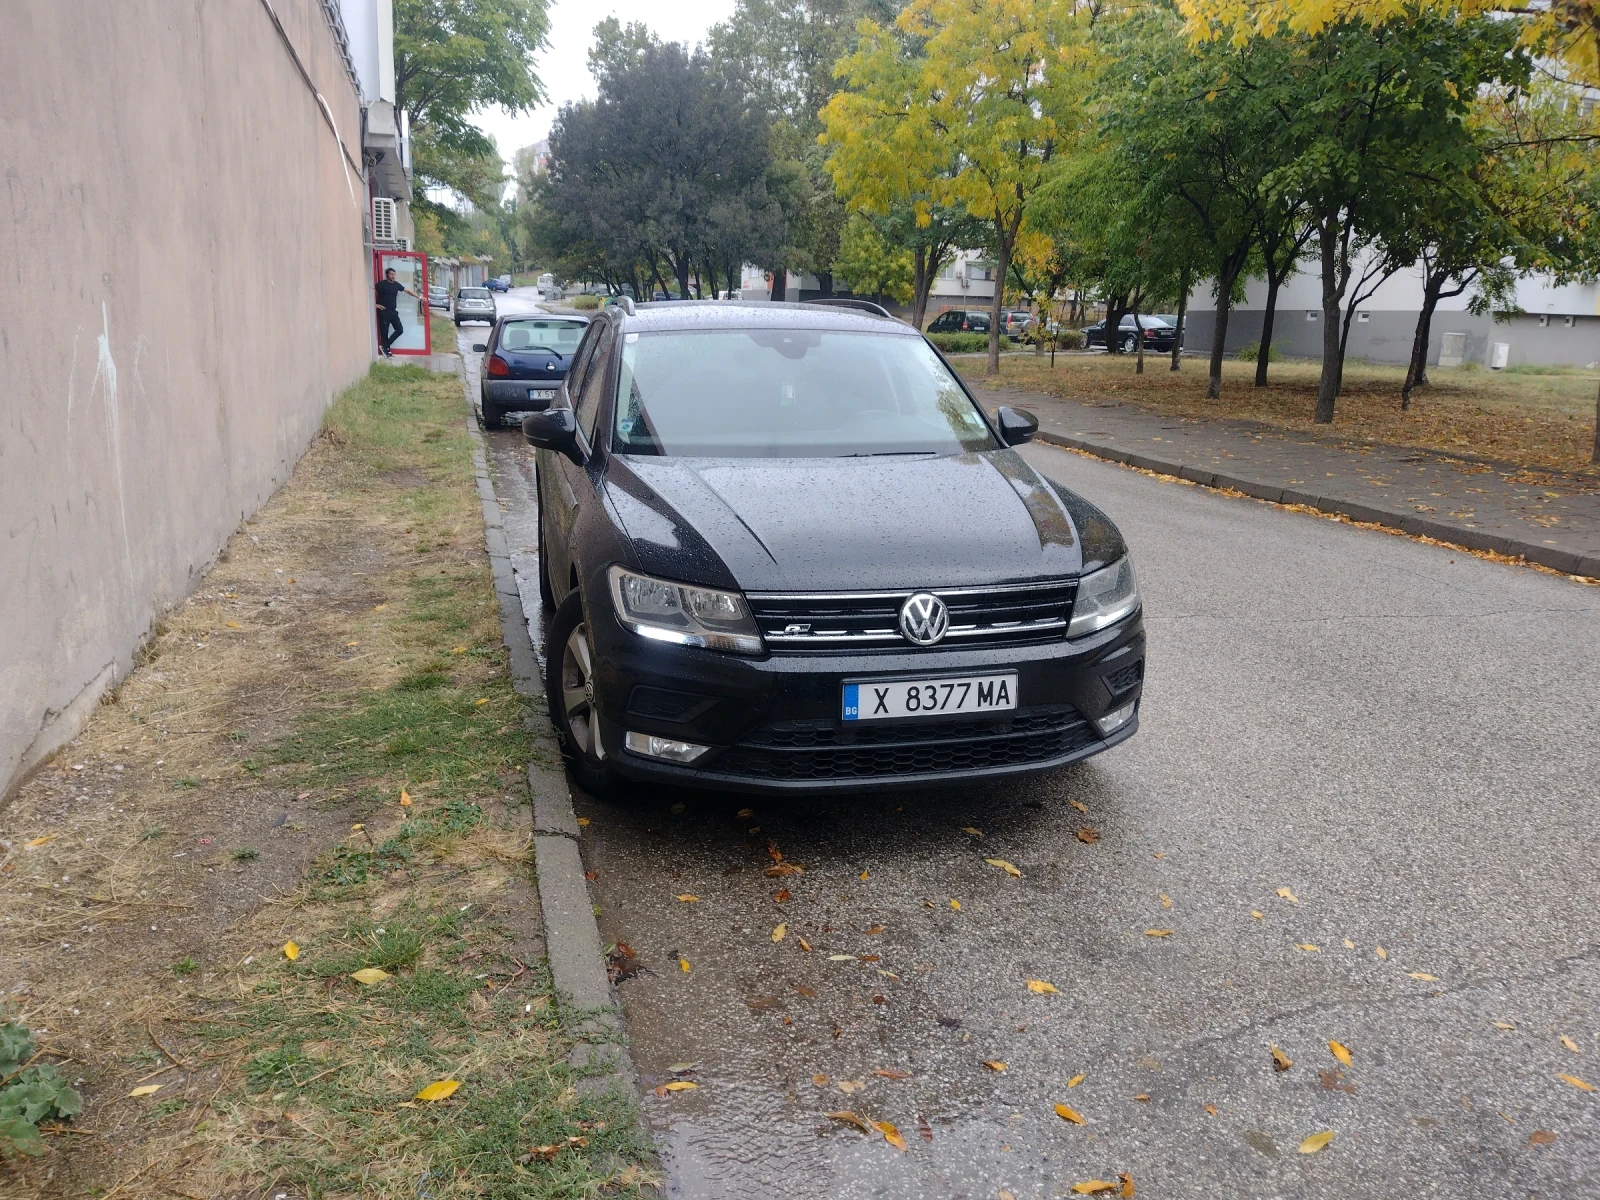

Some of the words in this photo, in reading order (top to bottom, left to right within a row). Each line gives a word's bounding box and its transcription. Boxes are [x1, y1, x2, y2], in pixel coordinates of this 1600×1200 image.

[845, 706, 857, 716] BG
[873, 687, 890, 715] X
[905, 682, 972, 712] 8377
[977, 679, 1011, 707] MA
